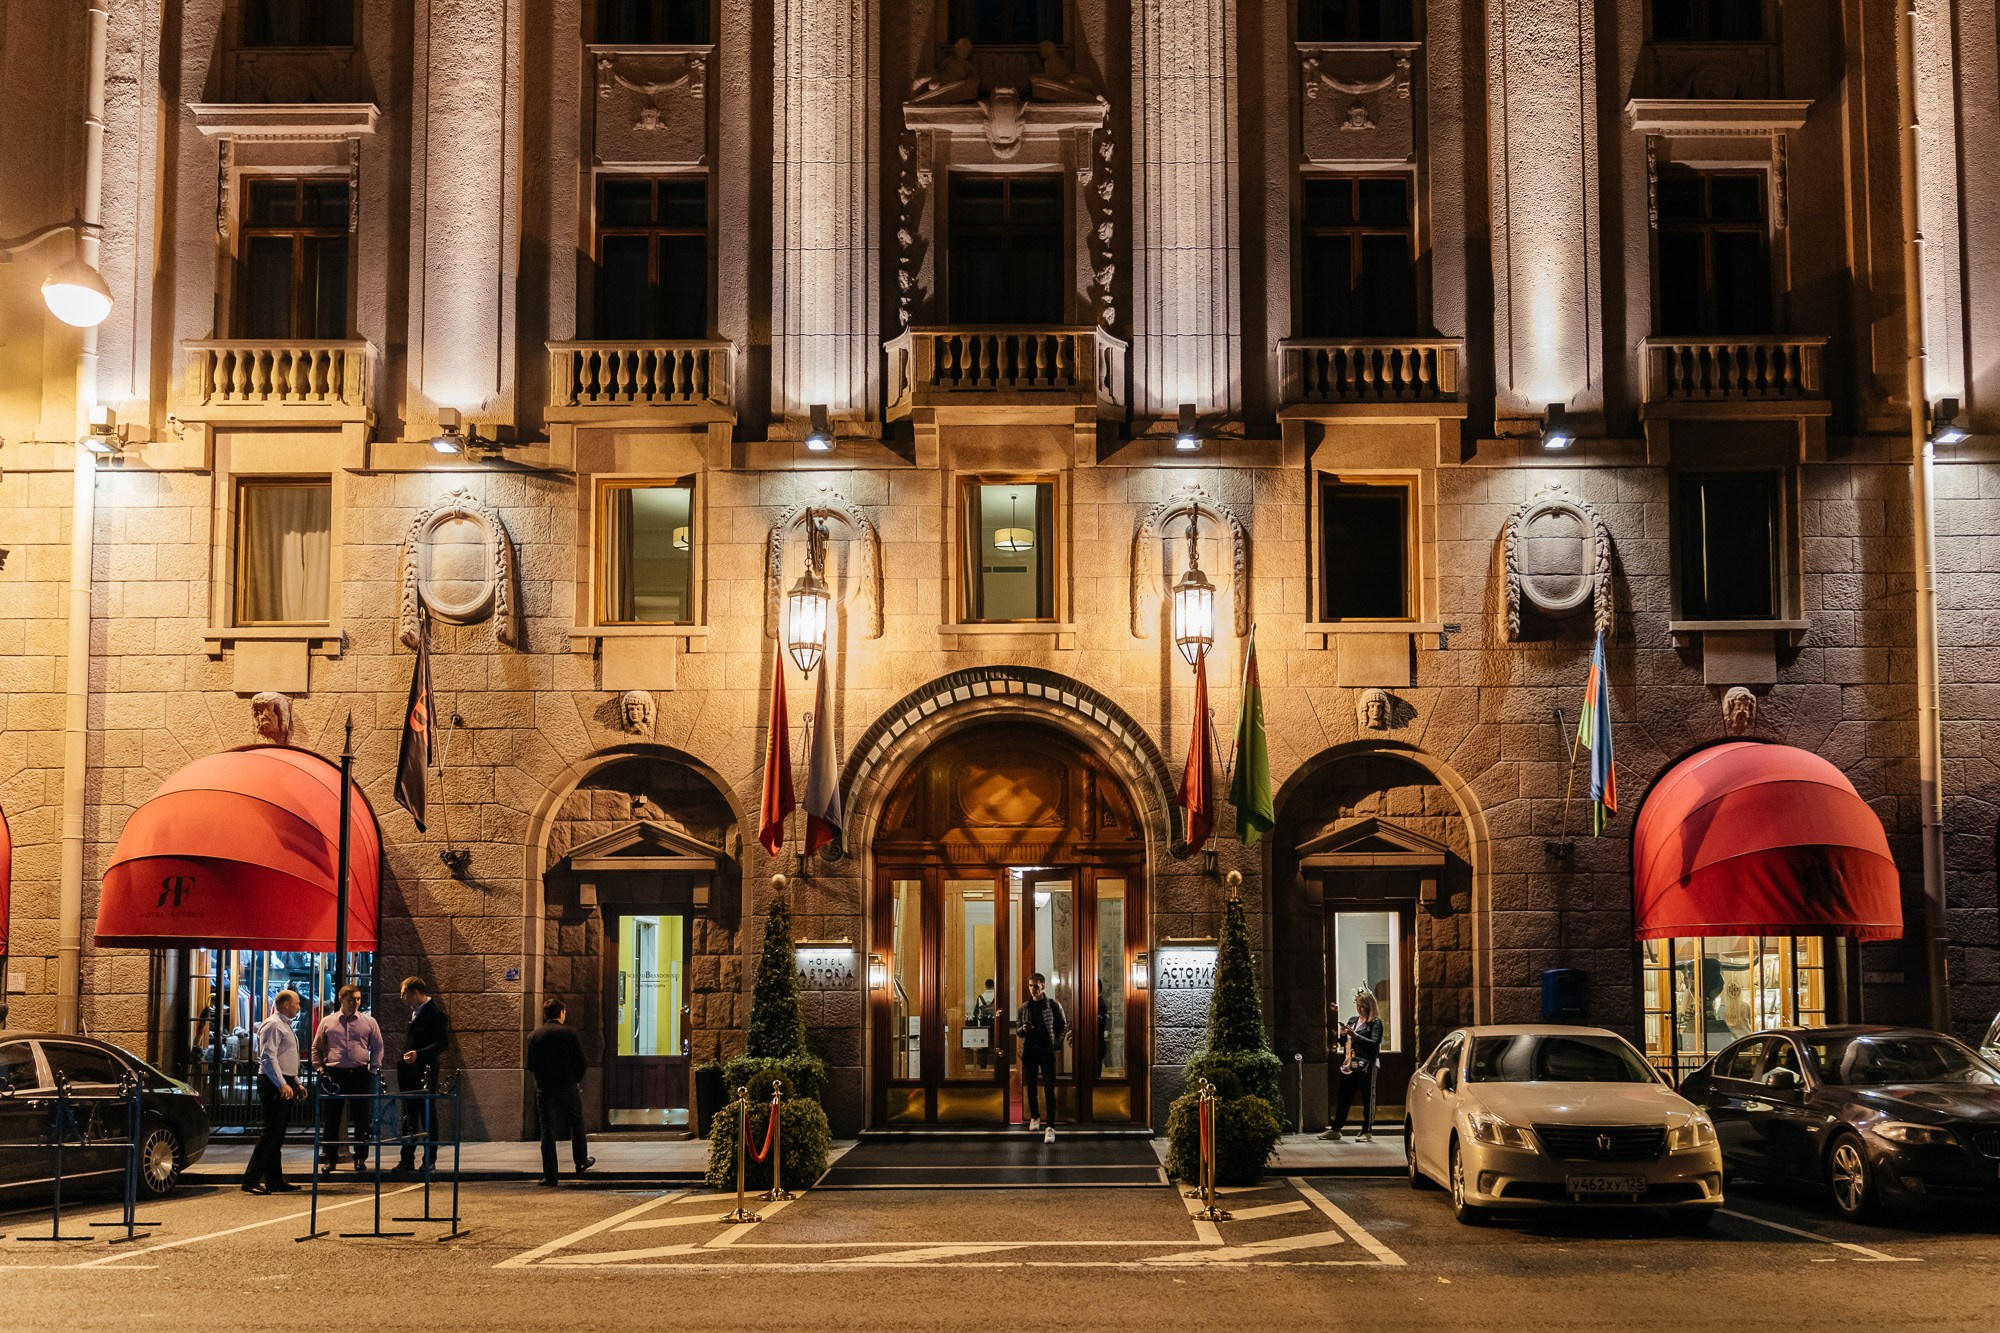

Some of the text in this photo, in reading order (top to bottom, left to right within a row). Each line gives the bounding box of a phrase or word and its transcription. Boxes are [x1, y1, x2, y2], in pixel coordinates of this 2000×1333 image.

[808, 958, 843, 966] HOTEL
[799, 968, 854, 980] ASTORIA
[1160, 967, 1216, 979] АСТОРИЯ
[1160, 979, 1211, 988] РЕСТОРА
